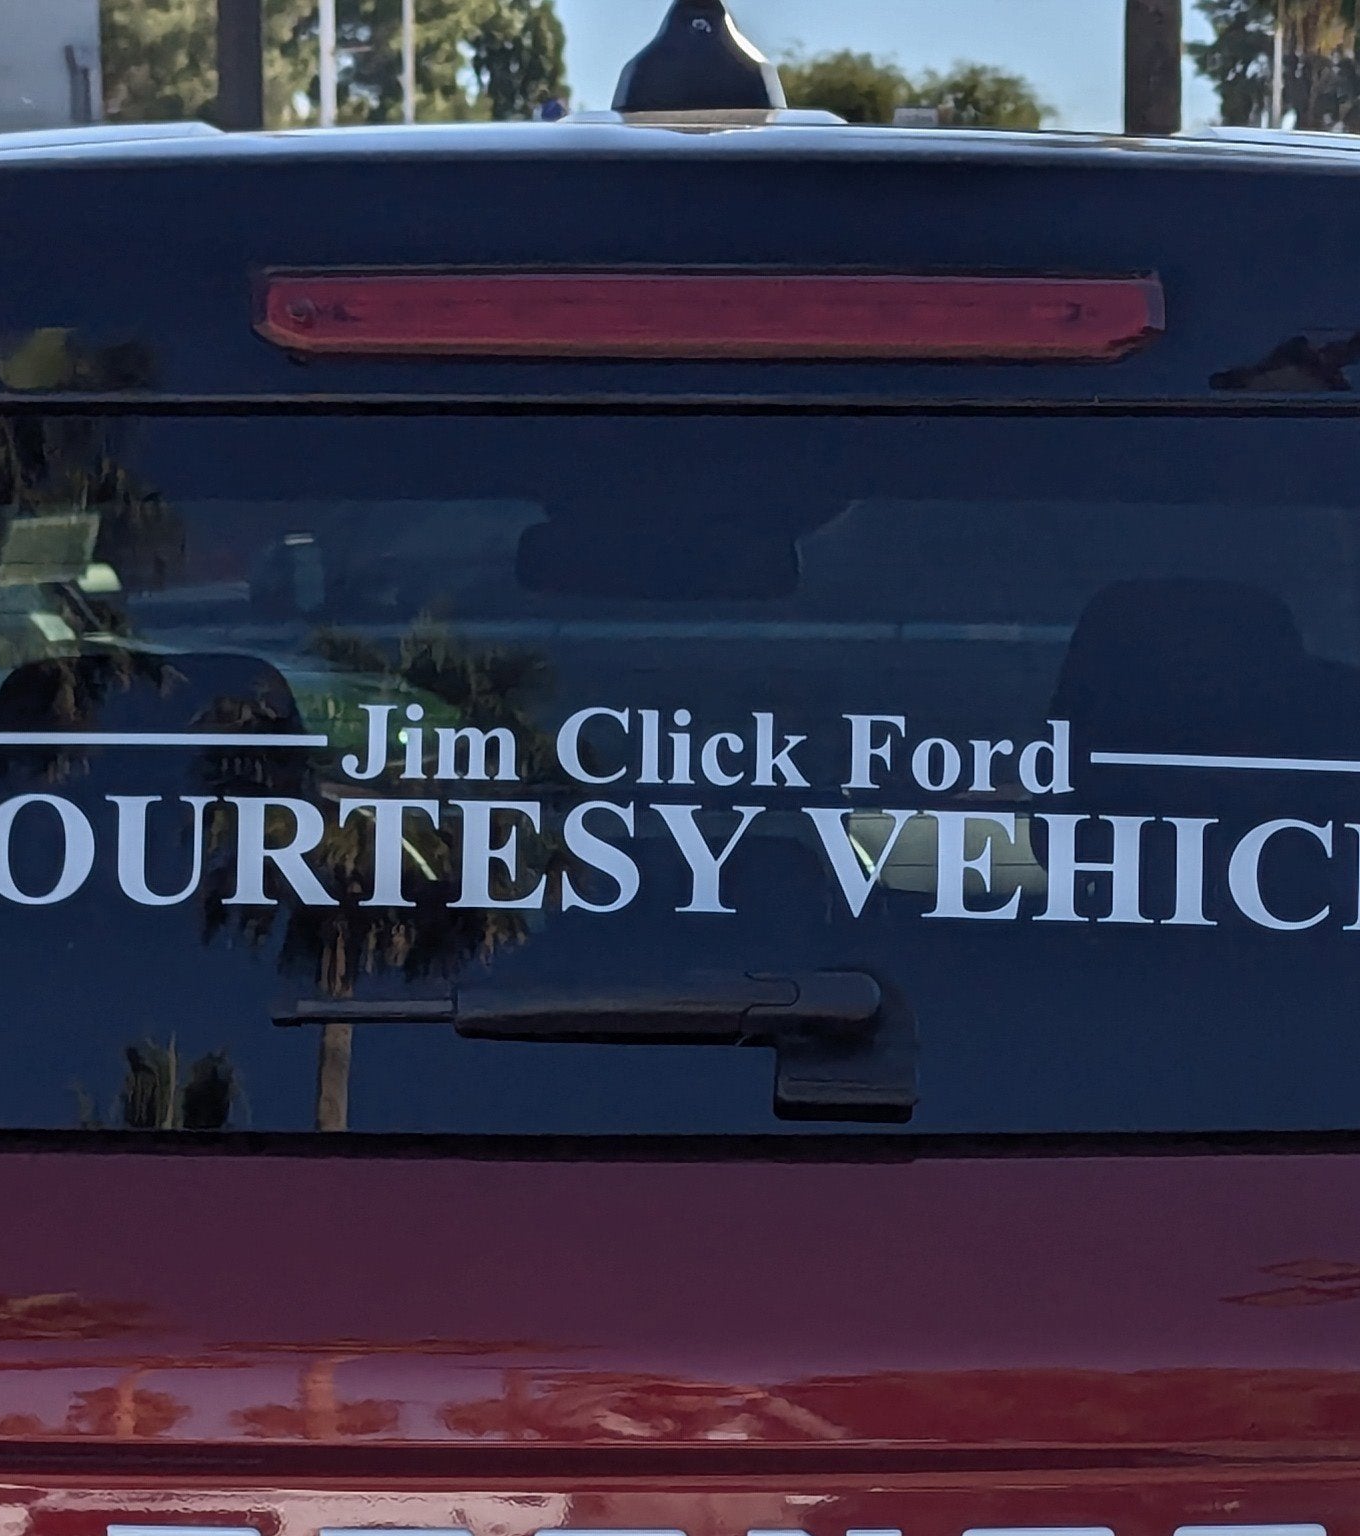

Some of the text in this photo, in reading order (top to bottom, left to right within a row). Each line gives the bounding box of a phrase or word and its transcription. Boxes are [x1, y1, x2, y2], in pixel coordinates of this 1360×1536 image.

[342, 704, 1074, 793] Jim Click Ford
